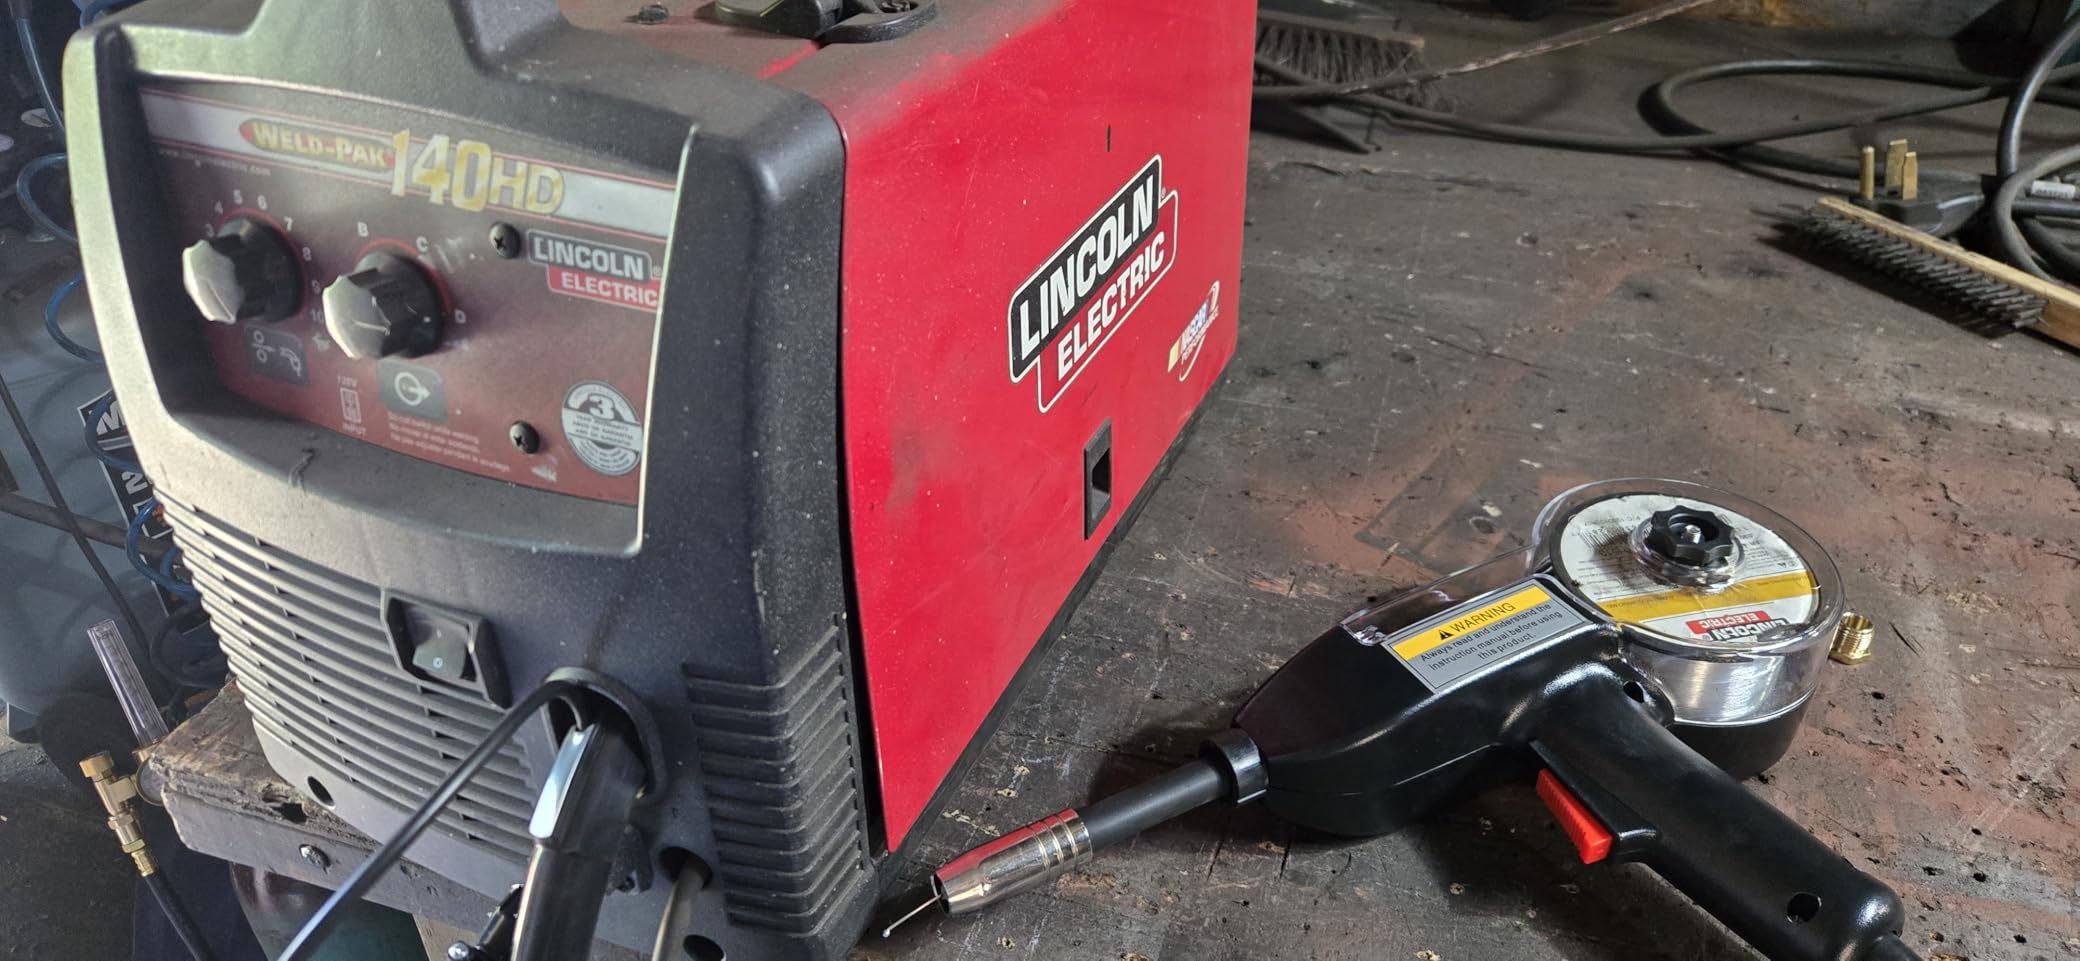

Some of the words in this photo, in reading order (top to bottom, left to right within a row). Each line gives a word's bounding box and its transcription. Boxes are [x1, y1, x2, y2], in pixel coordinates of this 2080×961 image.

[252, 121, 388, 168] WELD-PAK
[233, 190, 243, 204] 5
[257, 195, 268, 210] 6
[283, 217, 293, 231] 7
[357, 222, 369, 237] B
[416, 236, 428, 252] C
[534, 237, 645, 281] LINCOLN
[1019, 174, 1154, 361] LINCOLN
[561, 272, 658, 306] ELECTRIC
[1057, 231, 1165, 381] ELECTRIC
[589, 394, 615, 420] 3
[1421, 643, 1454, 661] Always
[1453, 634, 1474, 648] read
[1473, 627, 1490, 639] and
[1490, 608, 1537, 632] understand
[1536, 603, 1552, 613] the
[1449, 602, 1516, 633] WARNING
[1477, 630, 1510, 650] manual
[1508, 620, 1538, 636] before
[1537, 610, 1563, 624] using
[1698, 612, 1760, 629] ELECTRIC
[1477, 646, 1498, 660] this
[1497, 631, 1537, 653] product.
